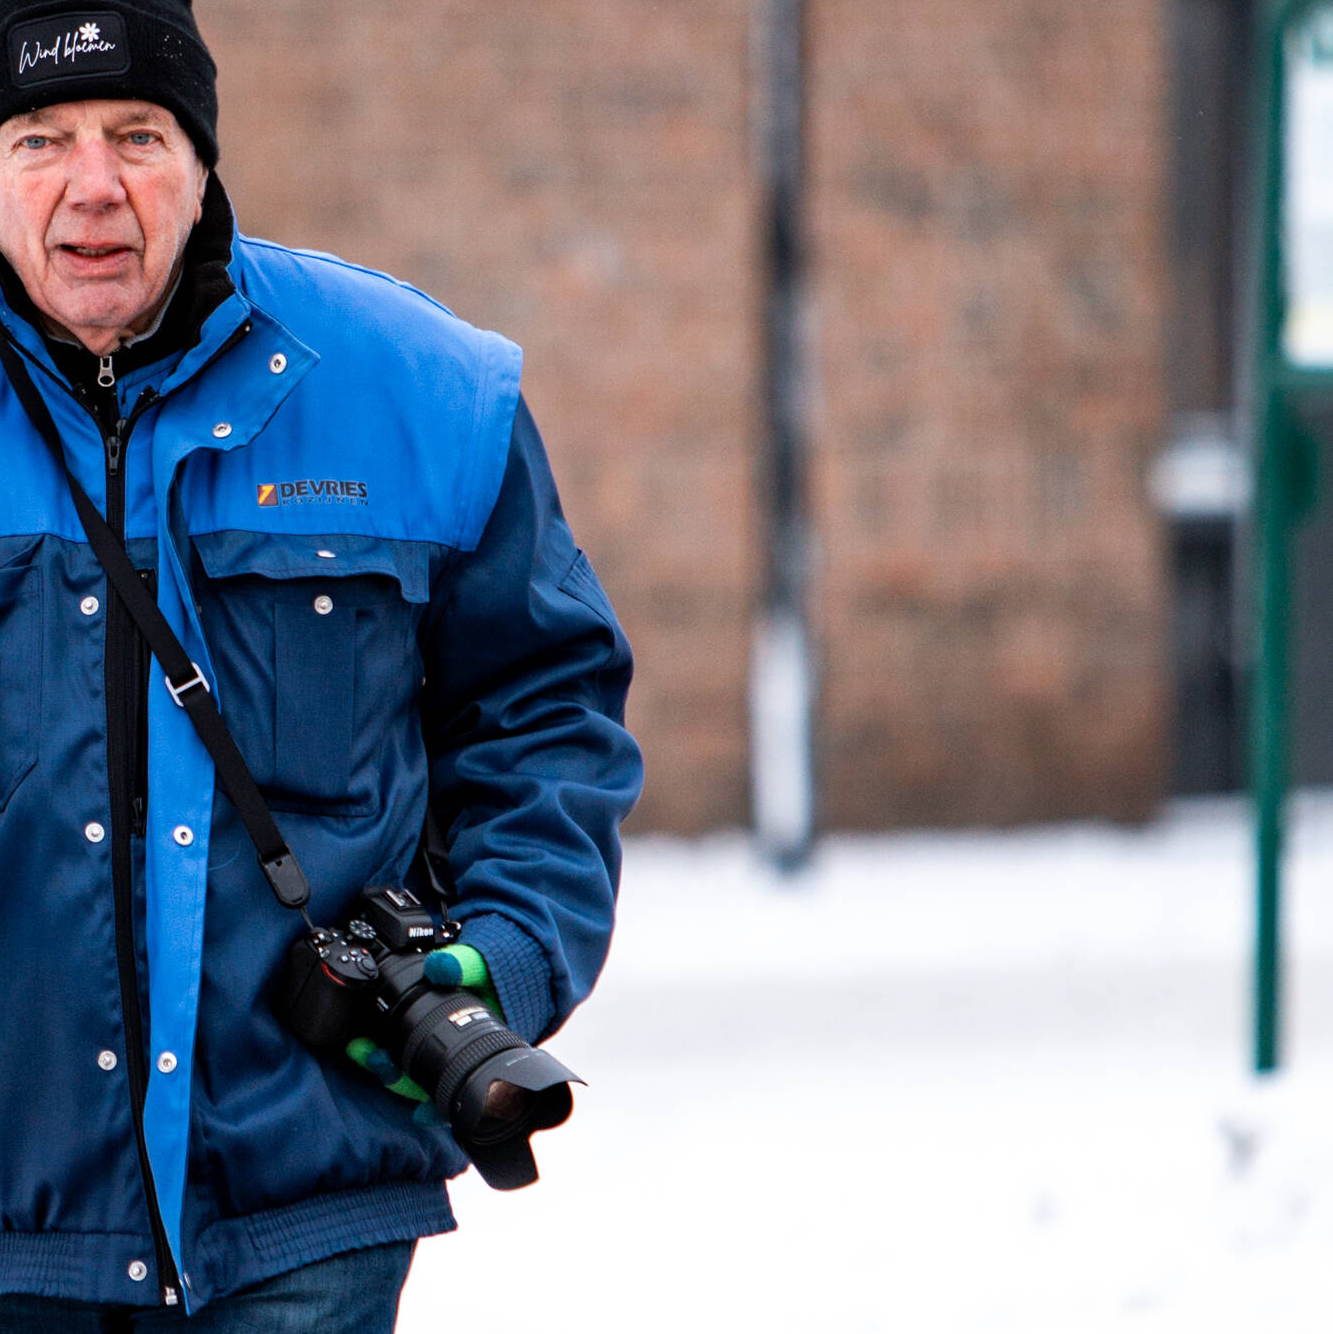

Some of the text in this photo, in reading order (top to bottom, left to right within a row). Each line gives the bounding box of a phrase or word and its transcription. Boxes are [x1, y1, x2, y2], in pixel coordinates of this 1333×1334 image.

[19, 31, 116, 74] Wind bloemen
[409, 928, 434, 938] Nikon
